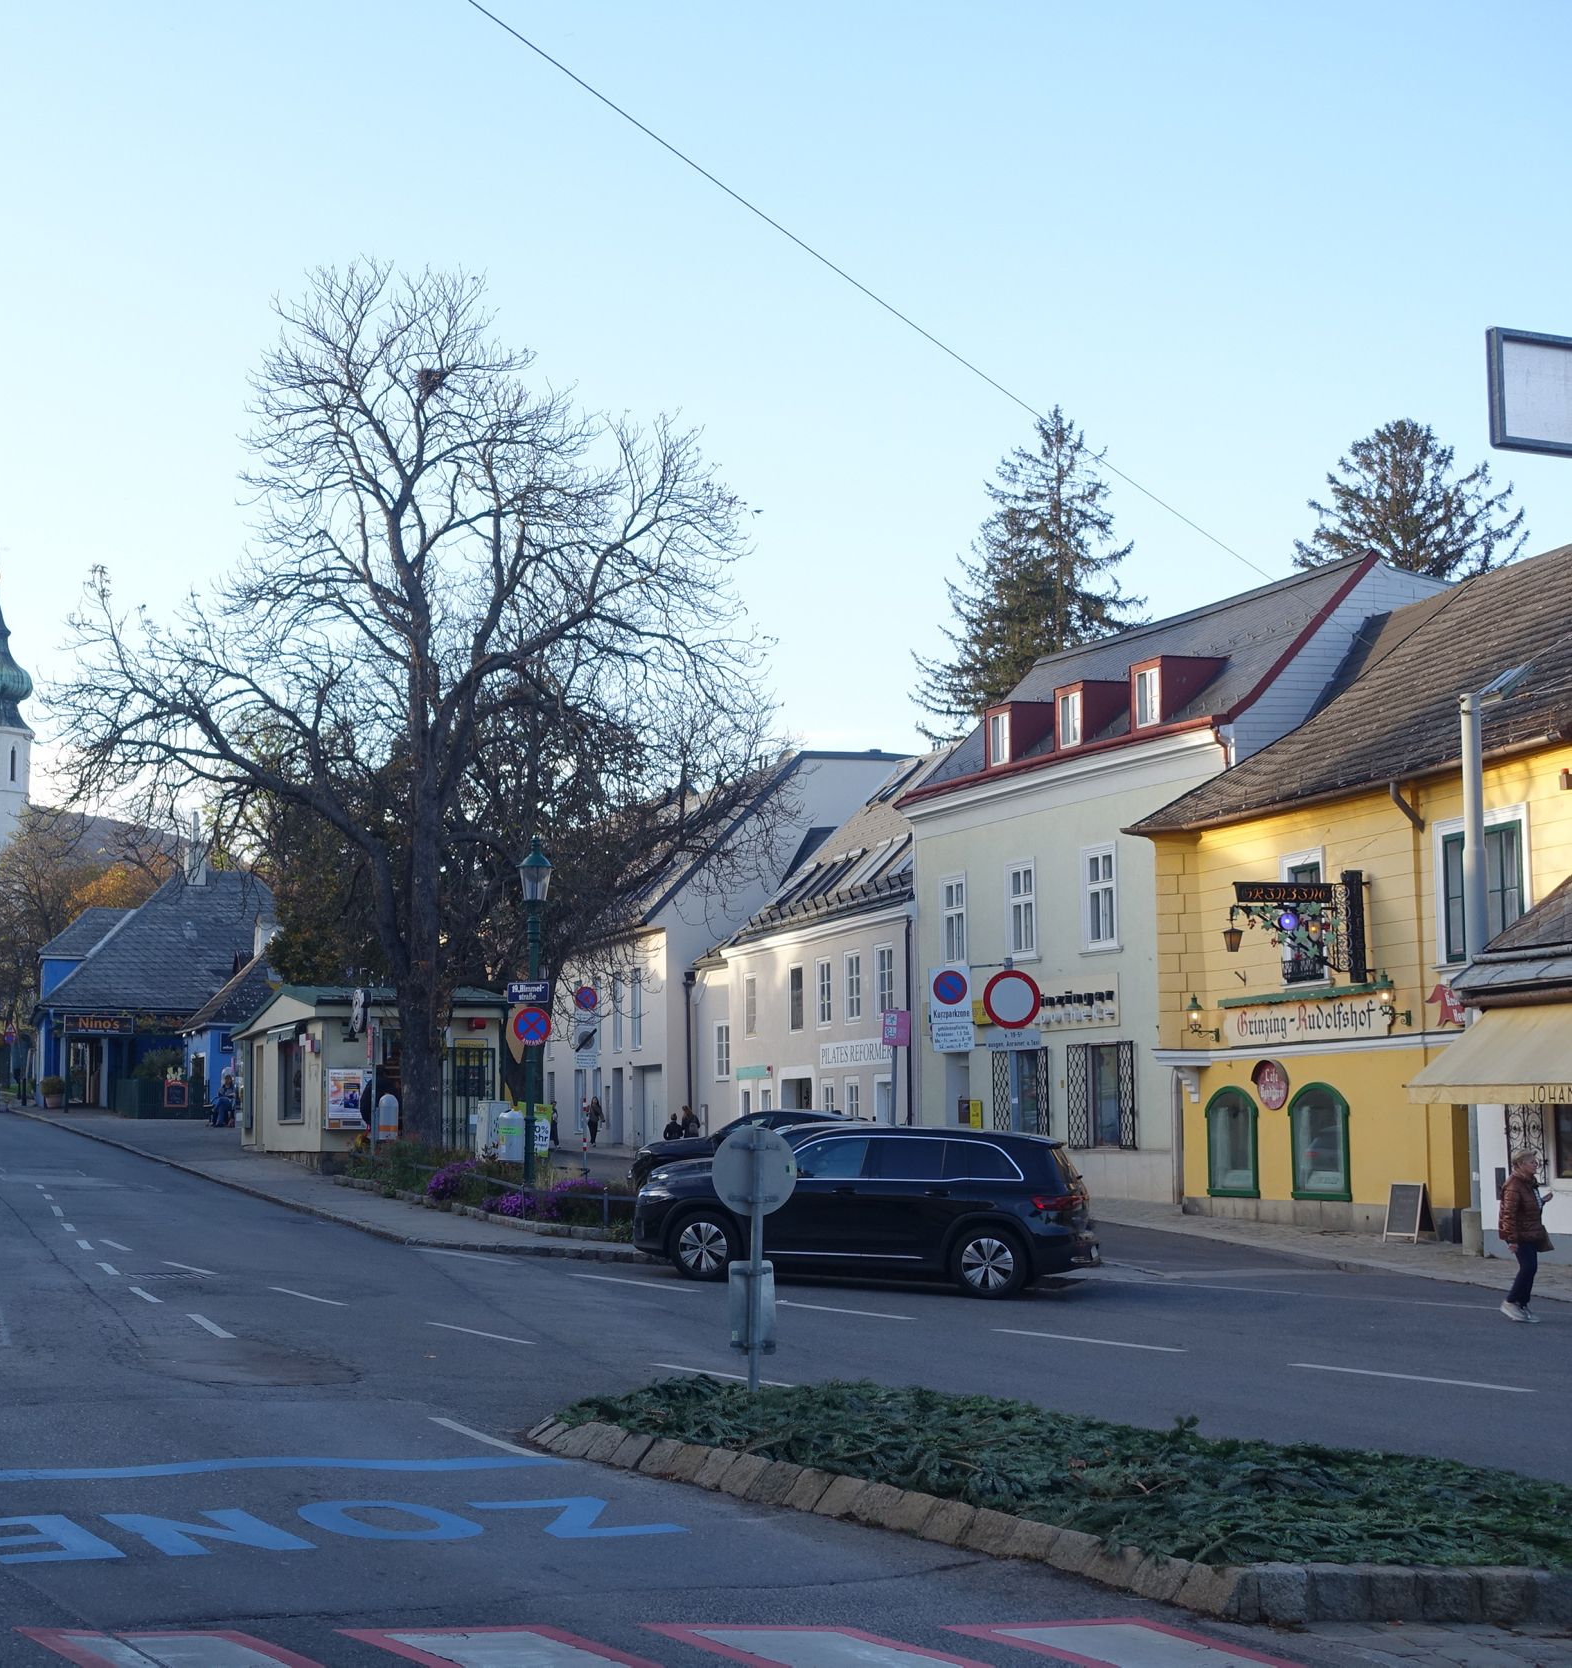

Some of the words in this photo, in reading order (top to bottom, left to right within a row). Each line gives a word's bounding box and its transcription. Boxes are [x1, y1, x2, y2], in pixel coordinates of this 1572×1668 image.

[933, 1009, 970, 1020] Kurzparkzone
[78, 1017, 120, 1030] Nino's
[821, 1045, 848, 1064] PILATES
[849, 1042, 893, 1062] REFORMER
[534, 1125, 549, 1135] 0%
